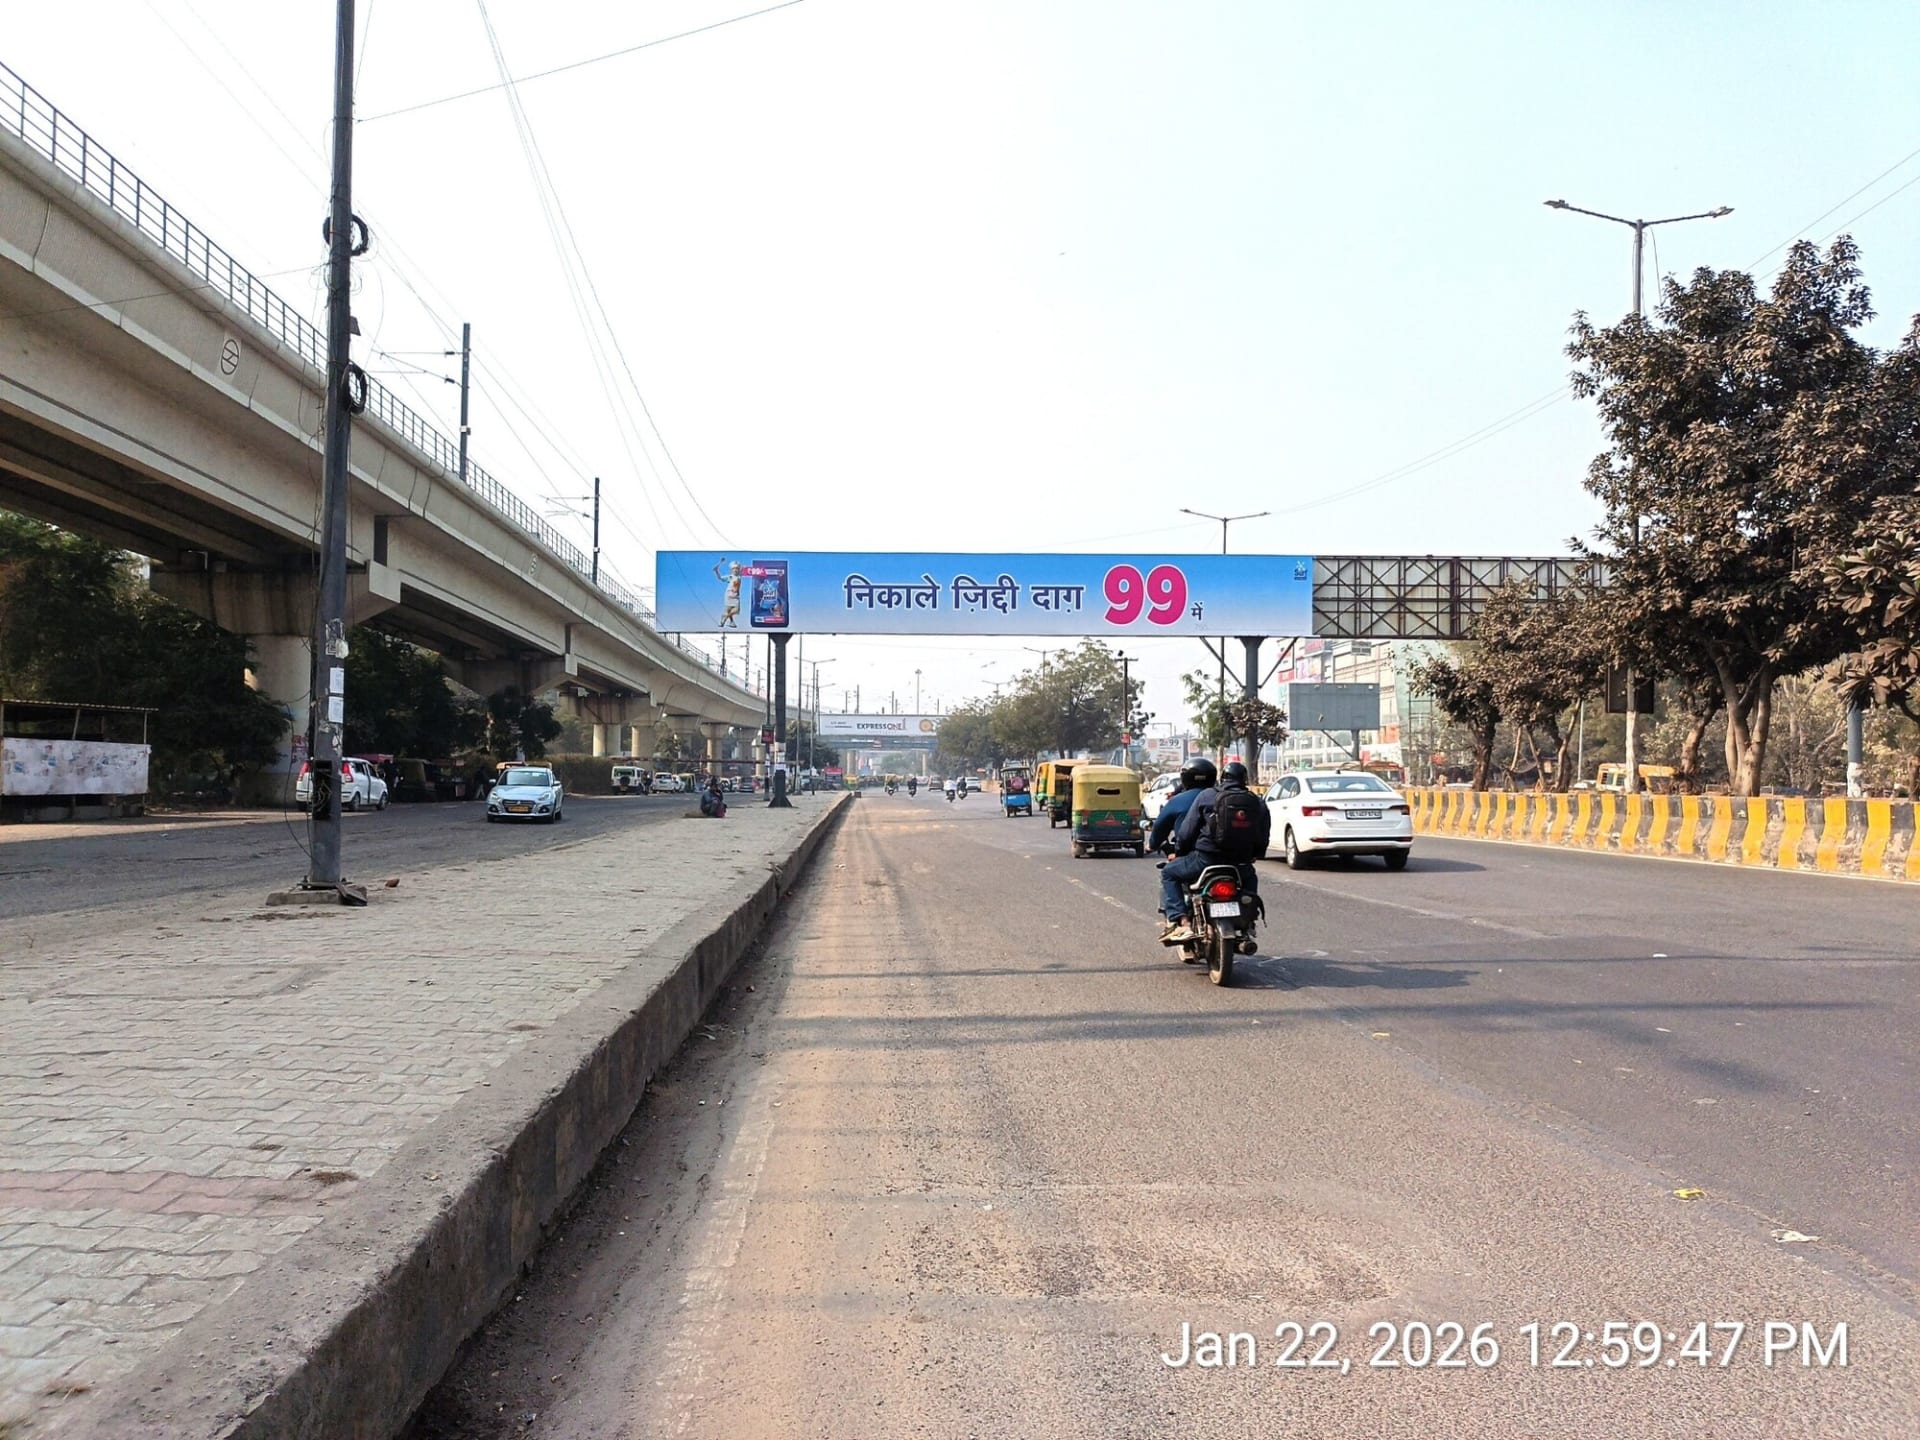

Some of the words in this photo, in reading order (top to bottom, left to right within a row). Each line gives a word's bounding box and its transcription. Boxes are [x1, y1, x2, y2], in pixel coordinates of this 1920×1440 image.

[843, 574, 941, 609] निकाले
[950, 574, 1020, 614] ज़िद्दी
[1030, 585, 1085, 613] दाग़
[1105, 566, 1187, 625] 99
[1190, 602, 1204, 621] में
